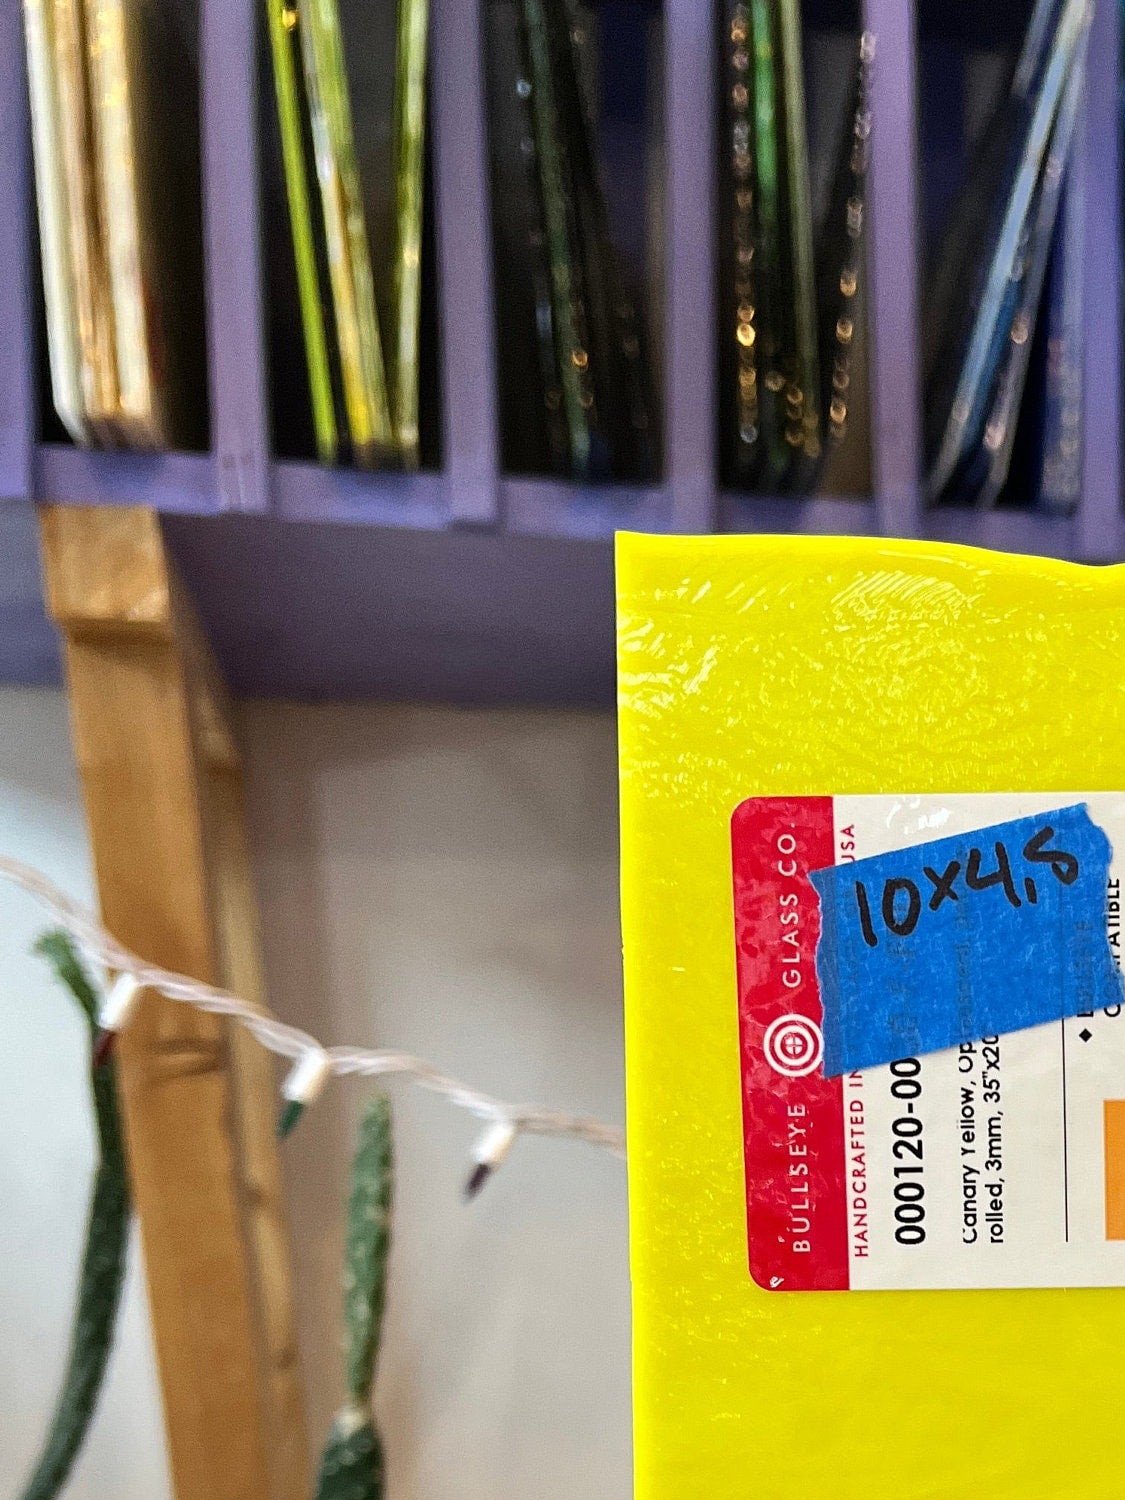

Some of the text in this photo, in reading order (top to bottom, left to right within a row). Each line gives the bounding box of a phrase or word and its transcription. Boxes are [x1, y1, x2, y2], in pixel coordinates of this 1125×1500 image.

[777, 823, 812, 1253] BULLSEYE GLASS CO.
[959, 1080, 978, 1156] Yellow,
[984, 1111, 1004, 1172] 3mm,
[849, 1099, 869, 1258] HANDCRAFTED
[961, 1164, 981, 1244] Canary
[984, 1176, 1005, 1244] rolled,
